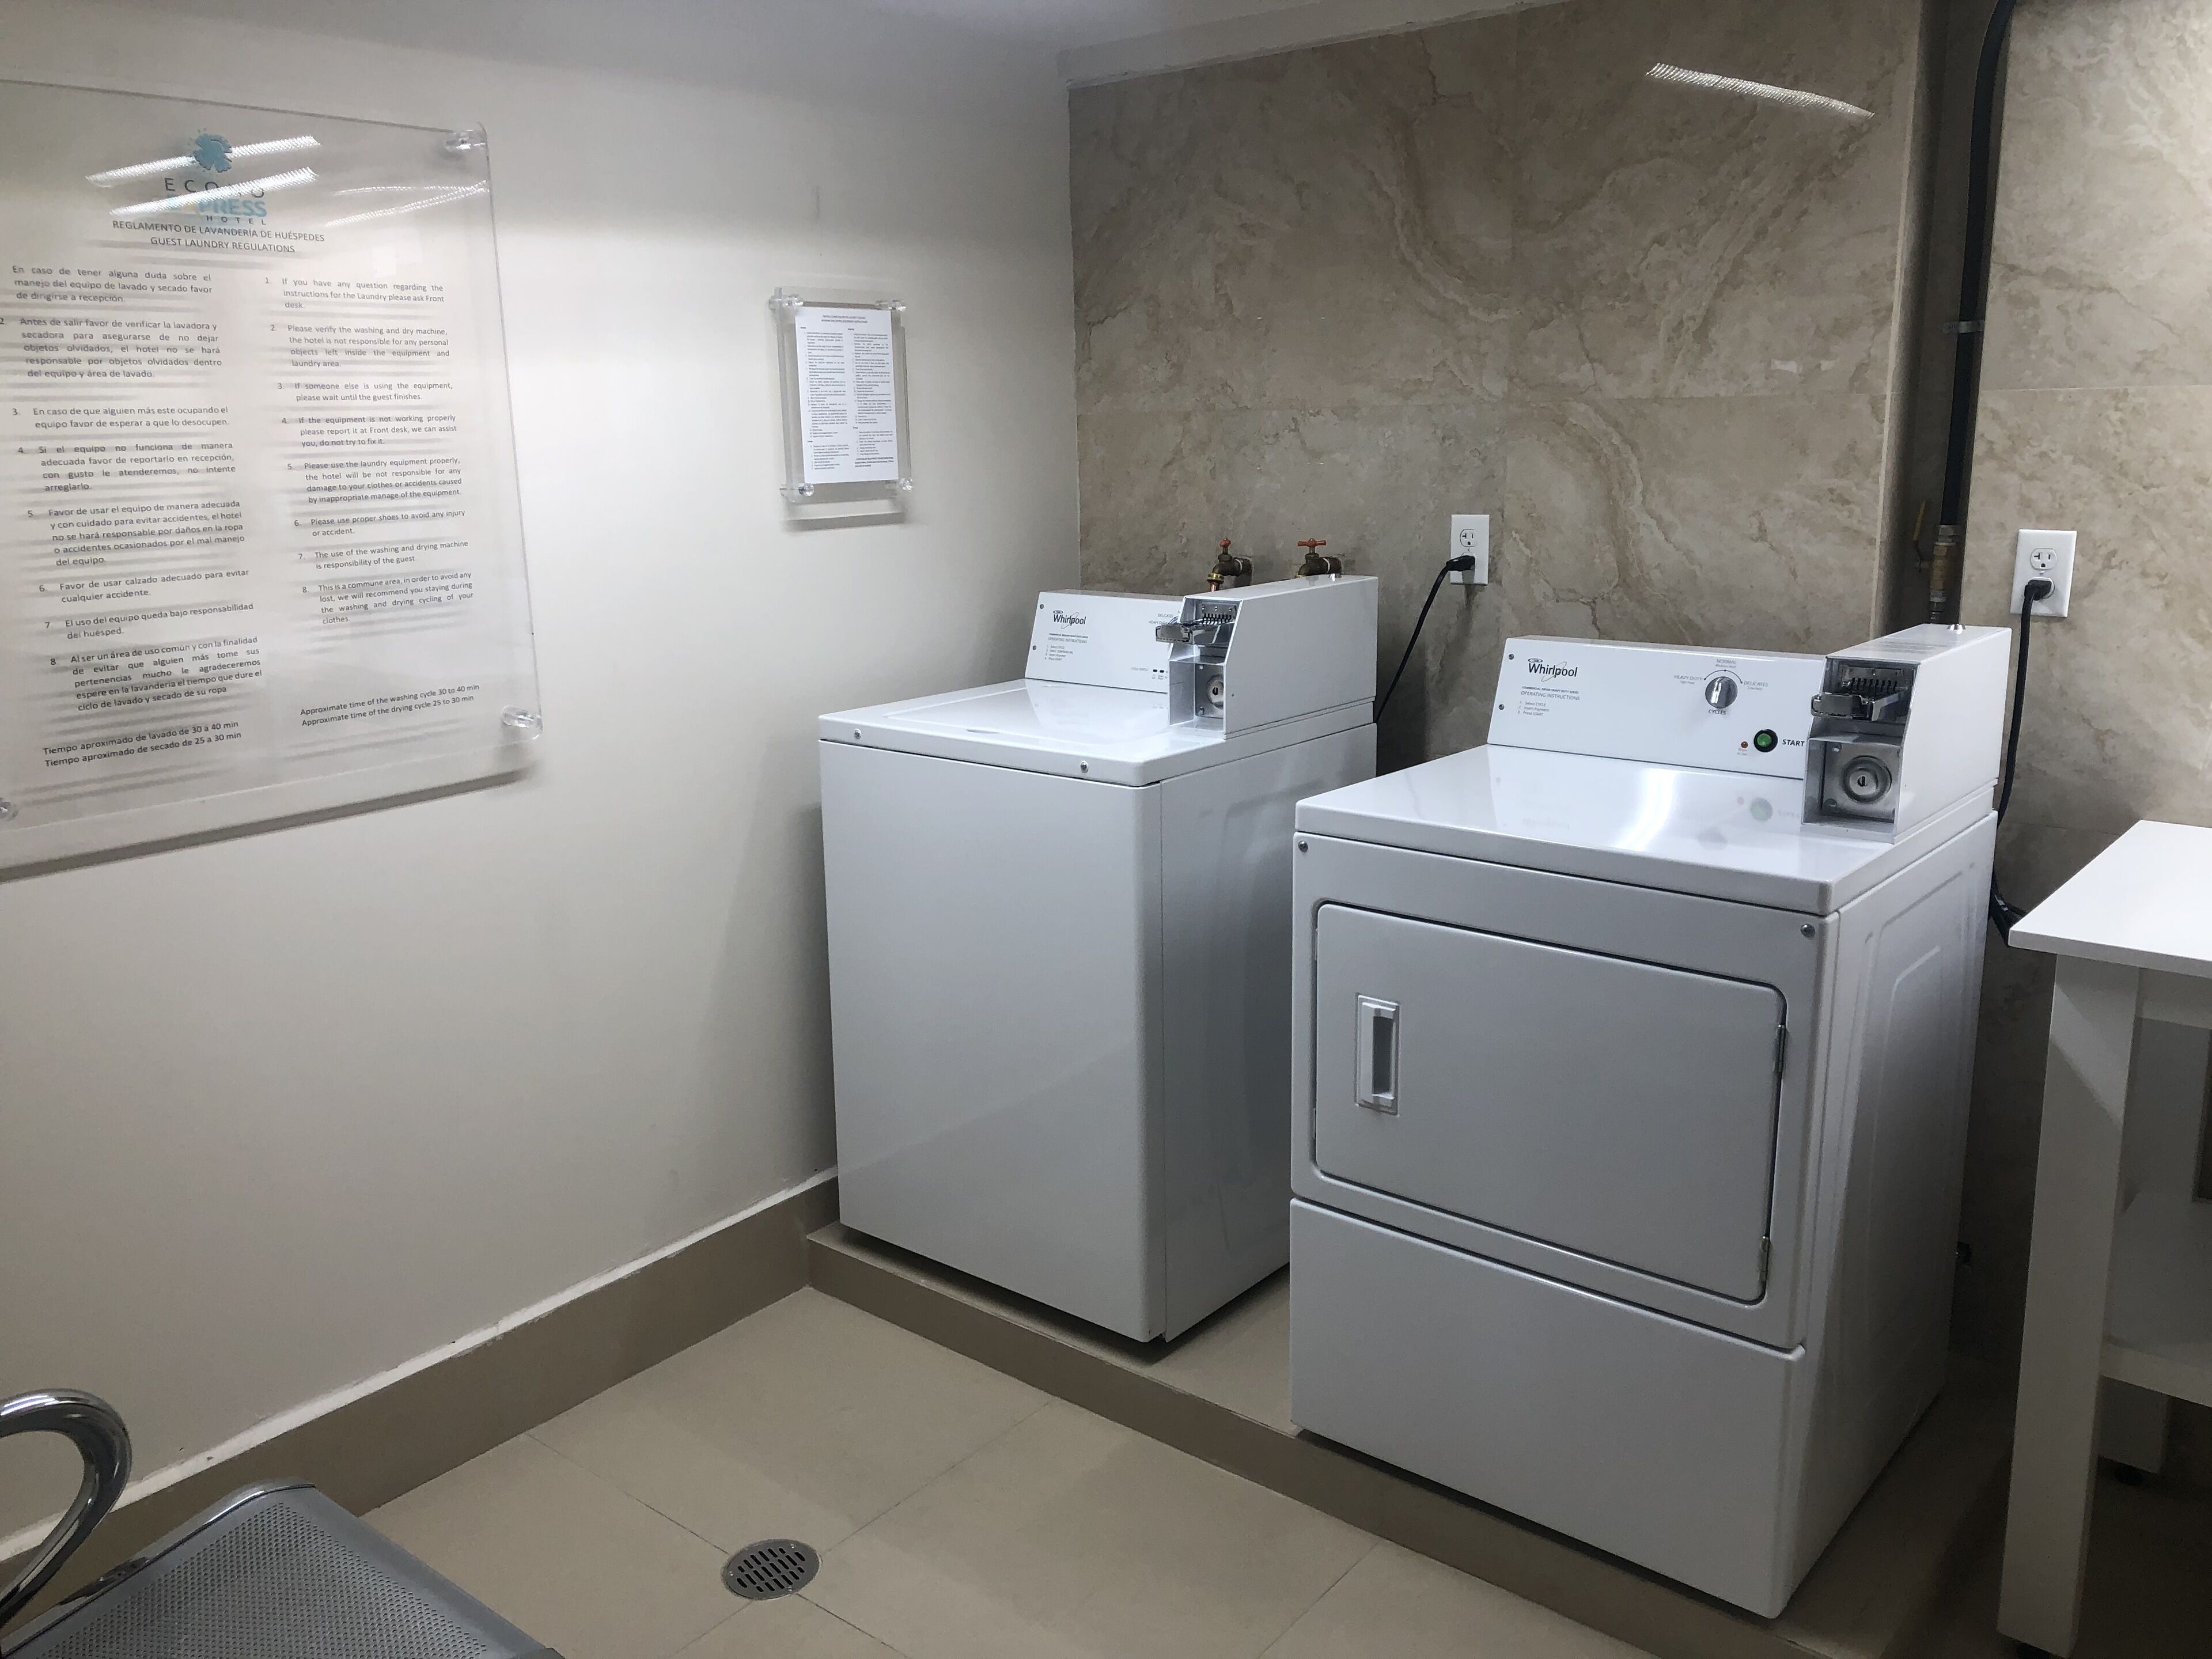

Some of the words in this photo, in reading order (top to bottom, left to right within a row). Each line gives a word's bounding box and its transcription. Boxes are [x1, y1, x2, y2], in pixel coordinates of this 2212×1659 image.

[207, 215, 267, 225] HOTEL
[112, 220, 181, 233] REGLAMENTO
[184, 225, 196, 234] DE
[199, 225, 258, 238] LAVANDERÍA
[260, 229, 272, 238] DE
[275, 229, 325, 242] HUÉSPEDES
[150, 236, 181, 247] GUEST
[185, 238, 229, 249] LAUNDRY
[232, 241, 296, 253] REGULATIONS
[13, 266, 23, 274] En
[59, 267, 70, 276] de
[77, 268, 101, 277] tener
[108, 269, 138, 279] alguna
[144, 270, 166, 279] duda
[173, 271, 197, 281] sobre
[203, 272, 211, 281] el
[14, 279, 50, 290] manejo
[53, 280, 67, 289] del
[70, 281, 101, 291] equipo
[104, 281, 115, 290] de
[118, 282, 147, 291] lavado
[150, 285, 154, 293] y
[158, 283, 188, 293] secado
[190, 284, 213, 293] favor
[313, 279, 331, 287] have
[337, 282, 350, 290] any
[356, 282, 388, 290] question
[393, 283, 427, 293] regarding
[16, 291, 28, 300] de
[31, 291, 67, 302] dirigirse
[283, 289, 328, 298] instructions
[330, 291, 340, 299] for
[357, 292, 387, 302] Laundry
[388, 293, 411, 302] please
[412, 294, 424, 302] ask
[426, 294, 445, 302] Front
[294, 381, 300, 389] If
[344, 381, 358, 389] else
[373, 382, 392, 391] using
[397, 381, 408, 389] the
[296, 393, 320, 403] please
[358, 392, 371, 400] the
[373, 393, 392, 402] guest
[33, 407, 44, 415] En
[70, 406, 81, 415] de
[83, 408, 100, 417] que
[103, 406, 135, 417] alguien
[137, 406, 155, 415] más
[157, 407, 175, 415] este
[177, 406, 219, 416] ocupando
[221, 405, 228, 414] el
[35, 419, 67, 430] equipo
[70, 419, 93, 428] favor
[96, 419, 107, 427] de
[109, 421, 143, 429] esperar
[153, 420, 169, 429] que
[172, 418, 180, 426] lo
[60, 582, 84, 590] Favor
[88, 579, 99, 589] de
[103, 579, 122, 588] usar
[125, 575, 157, 586] calzado
[161, 572, 202, 583] adecuado
[204, 572, 223, 582] para
[226, 569, 249, 578] evitar
[61, 593, 103, 604] cualquier
[1054, 614, 1086, 626] Whirlpool
[1529, 663, 1578, 678] Whirlpool
[300, 703, 347, 716] Approximate
[349, 700, 365, 709] time
[367, 697, 374, 706] of
[376, 696, 388, 704] the
[389, 692, 418, 702] washing
[419, 689, 436, 700] cycle
[438, 688, 447, 696] 30
[457, 685, 465, 693] 40
[467, 683, 480, 692] min
[301, 713, 349, 727] Approximate
[350, 711, 366, 719] time
[368, 708, 375, 716] of
[377, 706, 389, 715] the
[391, 703, 412, 714] drying
[414, 700, 430, 711] cycle
[433, 699, 441, 707] 25
[451, 696, 460, 704] 30
[461, 694, 474, 702] min
[43, 744, 77, 755] Tiempo
[80, 735, 133, 751] aproximado
[135, 733, 146, 742] de
[148, 729, 177, 740] lavado
[179, 727, 189, 736] de
[192, 725, 202, 734] 30
[211, 722, 221, 732] 40
[223, 720, 240, 729] min
[1782, 739, 1805, 747] START
[44, 756, 79, 767] Tiempo
[82, 747, 134, 763] aproximado
[137, 744, 147, 753] de
[150, 740, 180, 752] secado
[181, 738, 192, 747] de
[194, 736, 204, 745] 25
[214, 733, 224, 742] 30
[226, 731, 242, 740] min
